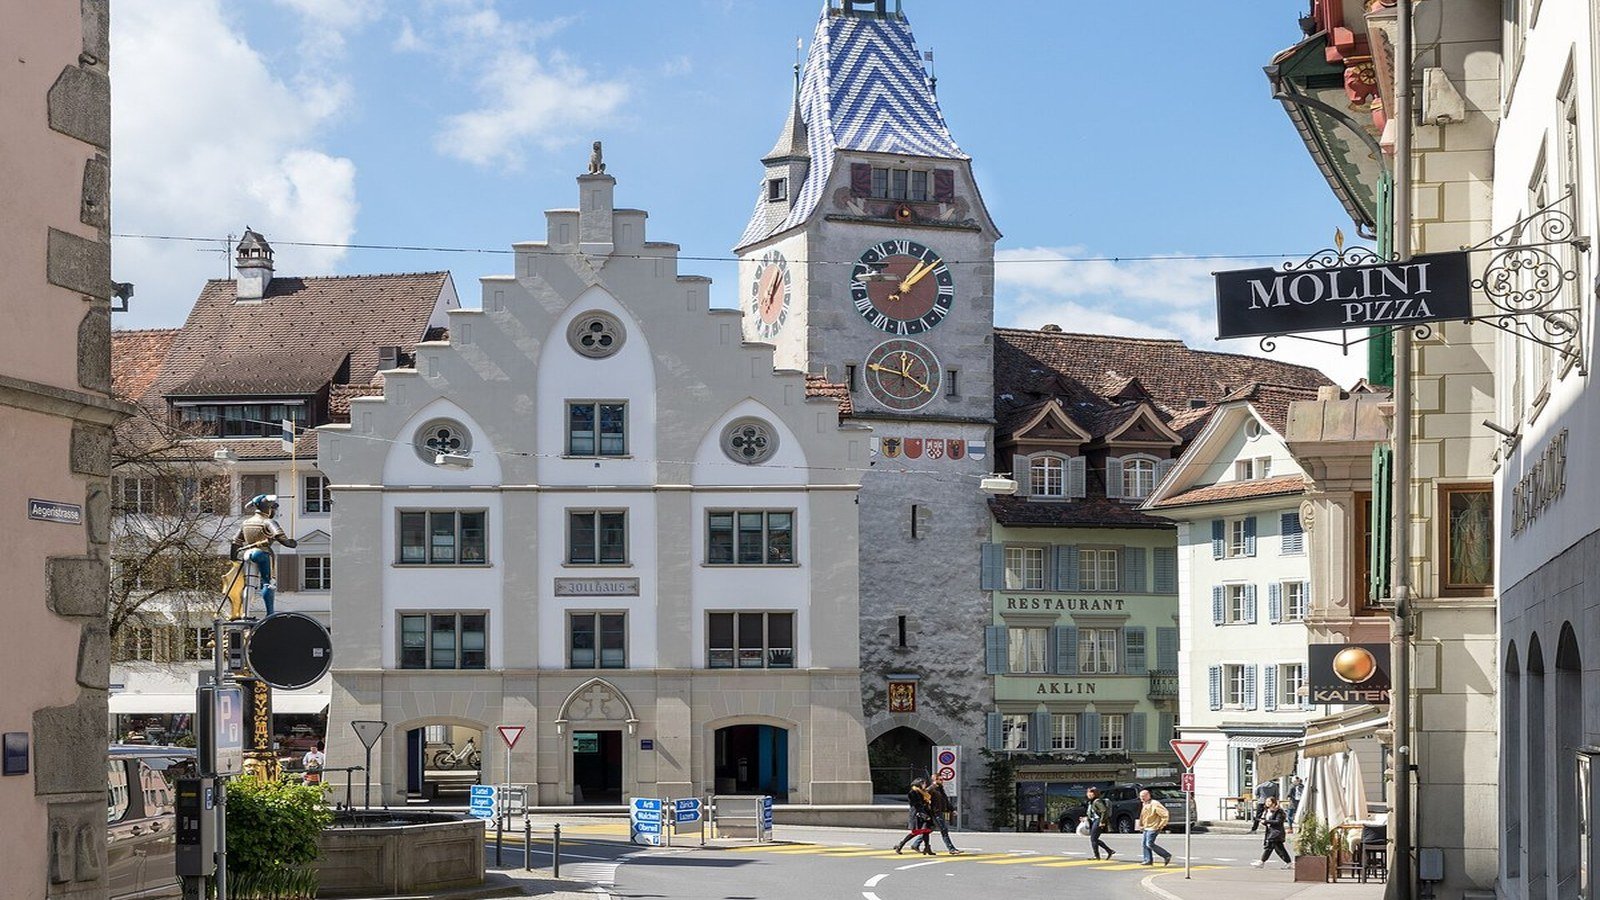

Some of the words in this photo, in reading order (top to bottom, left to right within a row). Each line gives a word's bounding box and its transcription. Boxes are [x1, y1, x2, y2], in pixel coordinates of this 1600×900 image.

[1247, 262, 1432, 310] MOLINI
[1341, 299, 1436, 324] PIZZA
[32, 503, 80, 520] Aegeristrasse
[1007, 597, 1125, 611] RESTAURANT
[1036, 682, 1096, 694] AKLIN
